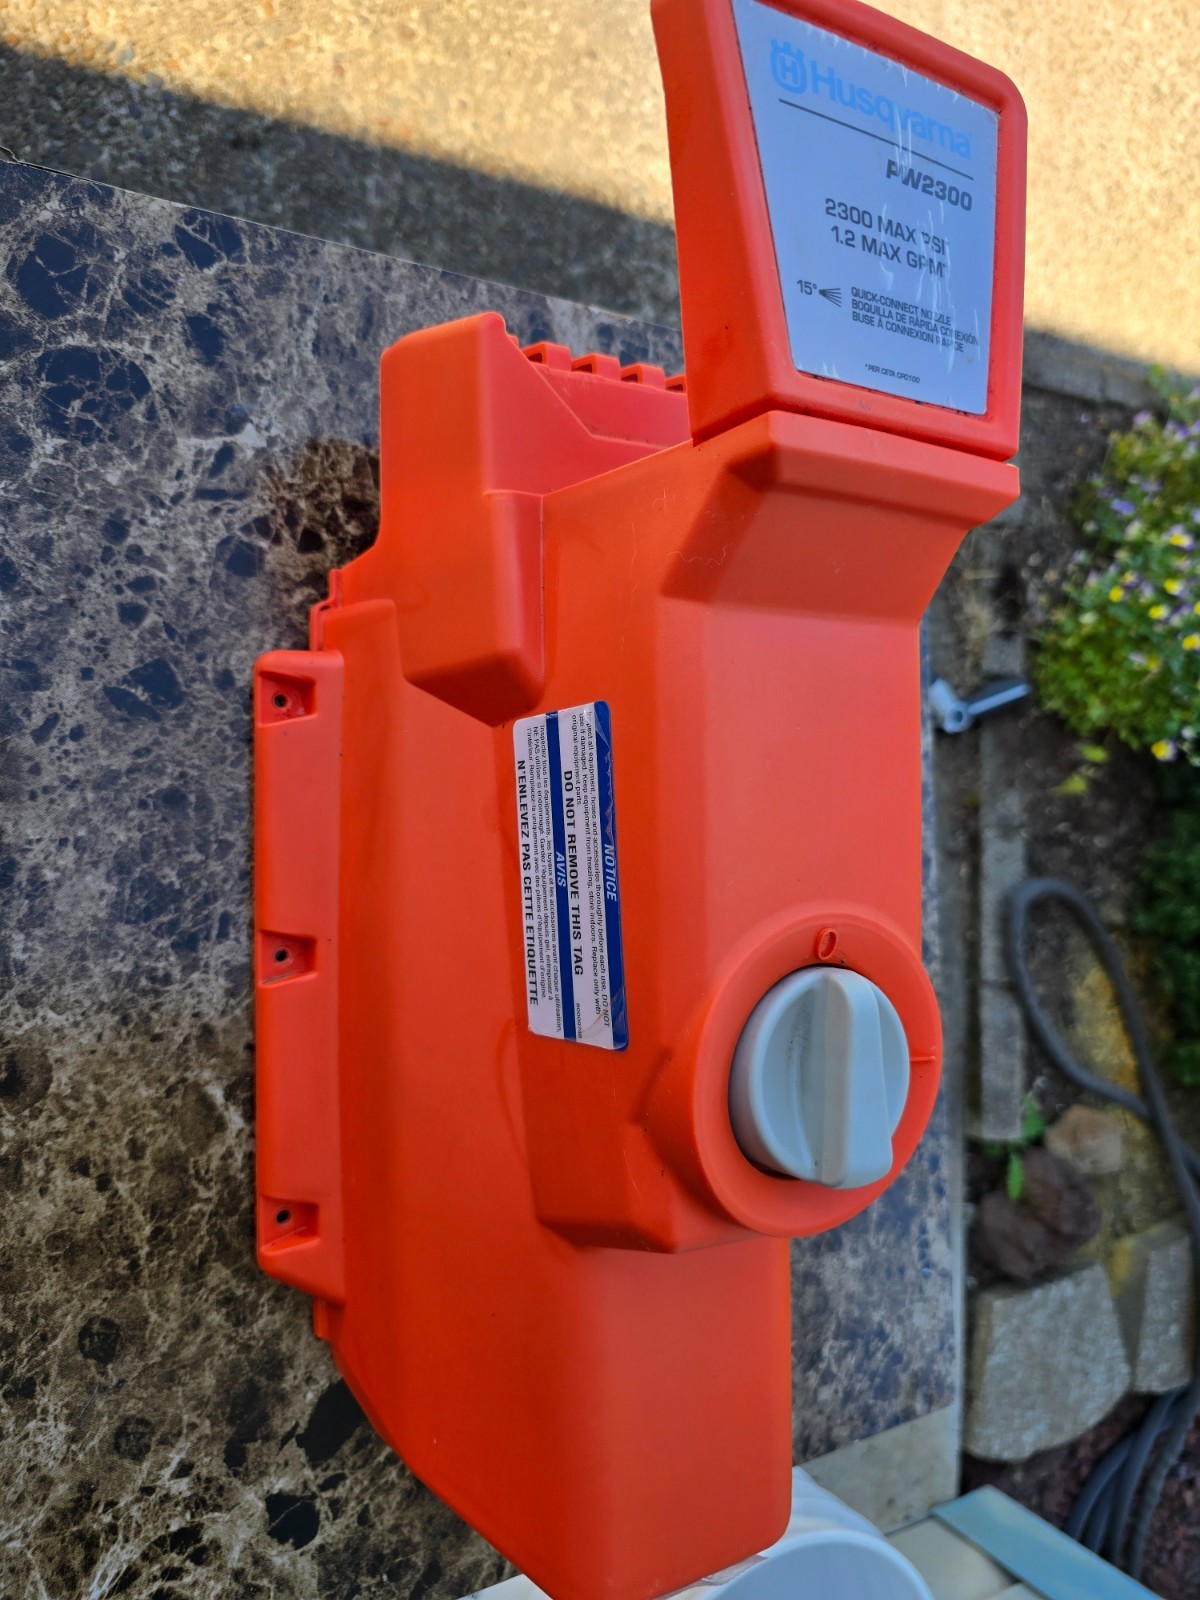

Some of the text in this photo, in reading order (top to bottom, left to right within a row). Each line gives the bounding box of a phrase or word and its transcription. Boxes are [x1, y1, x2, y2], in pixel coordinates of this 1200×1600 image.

[811, 60, 971, 159] Husqvarna
[886, 158, 972, 212] PW2300
[824, 195, 872, 230] 2300
[877, 214, 916, 245] MAX
[830, 223, 855, 248] 1.2
[861, 233, 900, 263] MAX
[796, 277, 817, 297] 15°
[851, 285, 918, 316] QUICK-CONNECT
[851, 298, 893, 319] BOQUILLA
[895, 311, 906, 323] DE
[852, 310, 874, 326] BUSE
[885, 320, 933, 343] CONNEXION
[935, 334, 963, 352] RAPDE
[533, 726, 538, 736] NE
[572, 745, 580, 784] equipment
[587, 752, 595, 794] equipment,
[582, 794, 590, 834] equipment
[555, 850, 566, 887] AVIS
[564, 770, 583, 975] DO NOT REMOVE THIS TAG
[585, 856, 593, 888] freezing,
[592, 837, 600, 882] accessories
[603, 843, 616, 901] NOTICE
[517, 760, 537, 1005] N'ENLEVEZ PAS CETTE ETIQUETTE
[594, 884, 603, 925] thoroughly
[602, 994, 607, 1006] DO
